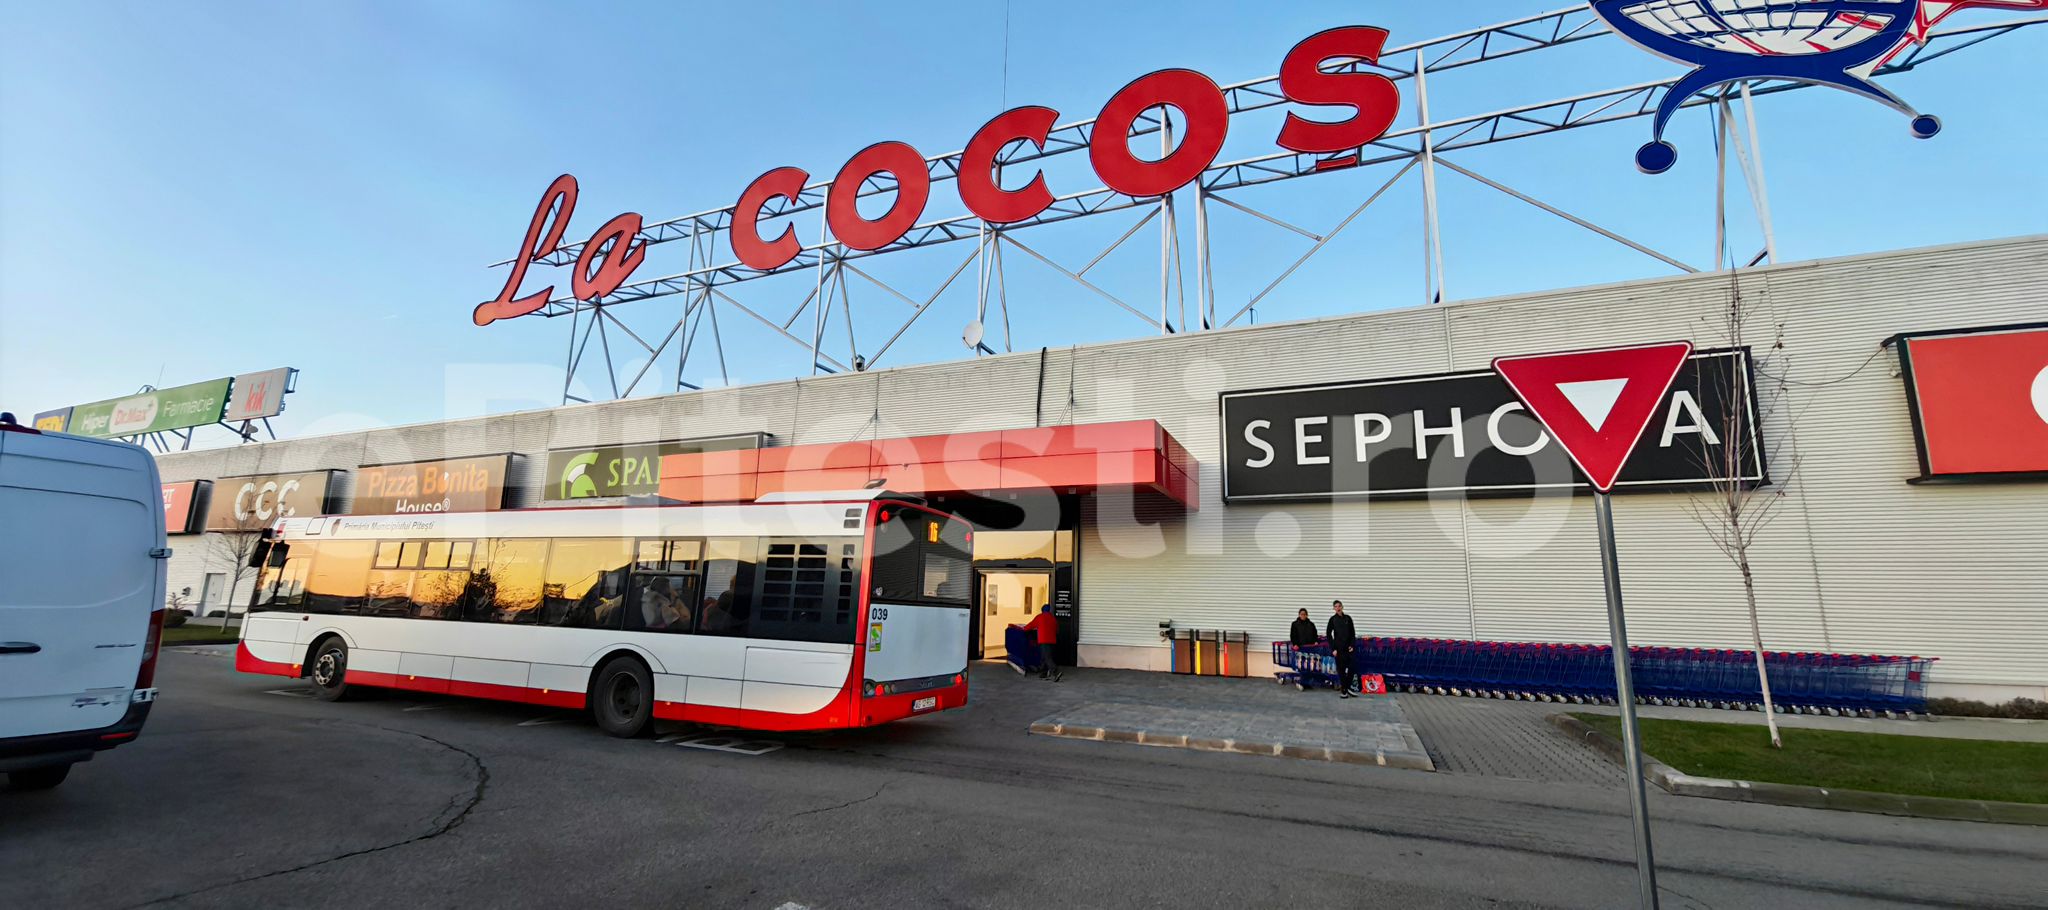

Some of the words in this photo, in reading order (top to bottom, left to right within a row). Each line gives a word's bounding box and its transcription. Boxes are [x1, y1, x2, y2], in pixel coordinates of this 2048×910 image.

[473, 174, 646, 326] La
[163, 396, 214, 417] Farmacie
[1244, 389, 1721, 469] SEPHOA
[368, 470, 418, 497] Pizza
[423, 463, 488, 495] Bonita
[235, 480, 299, 520] CCC
[872, 608, 888, 620] 039
